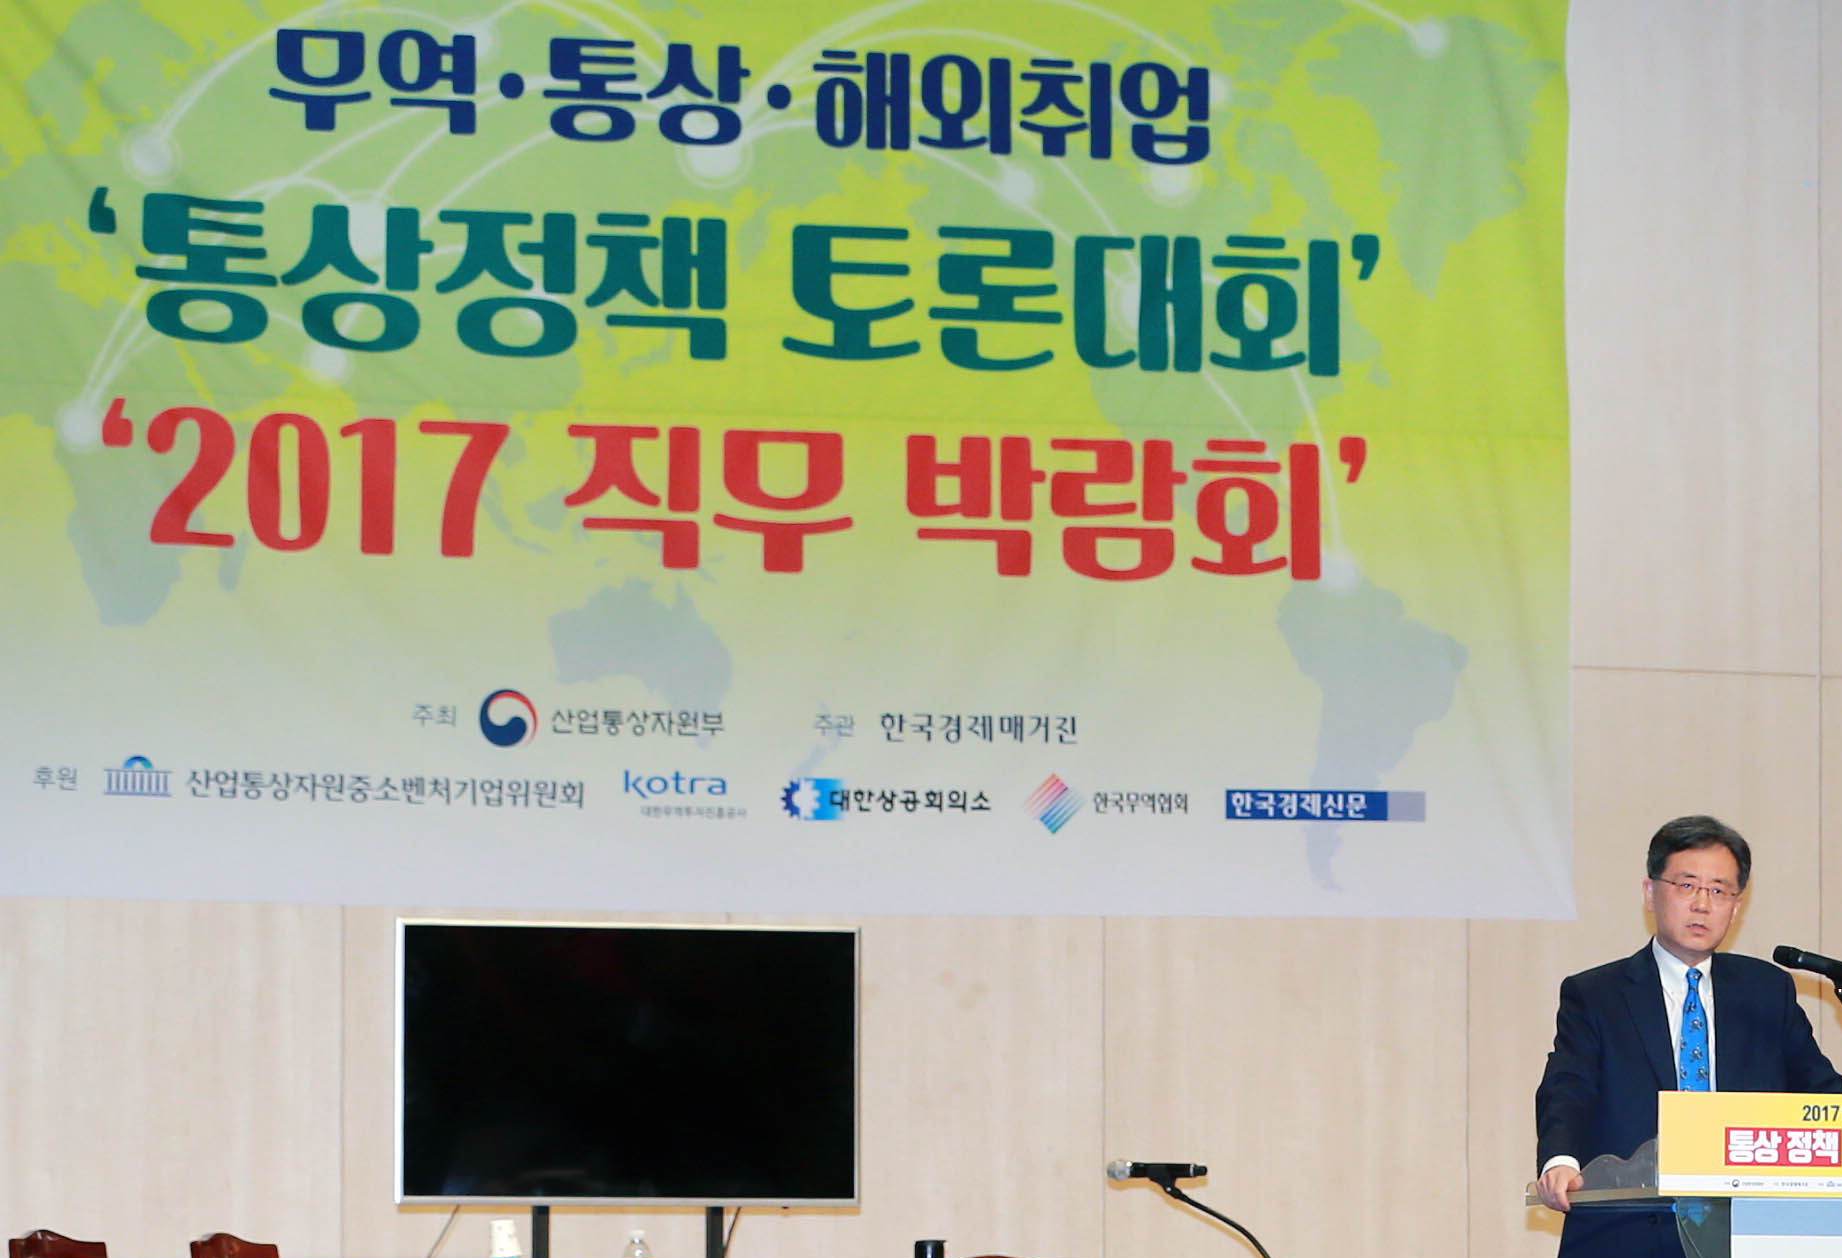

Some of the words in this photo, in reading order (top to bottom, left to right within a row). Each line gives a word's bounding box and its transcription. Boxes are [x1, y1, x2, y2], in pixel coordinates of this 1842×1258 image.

[269, 28, 1211, 166] 무역·통상·해외취업
[564, 422, 854, 574] 직무
[411, 703, 457, 728] 주최
[551, 708, 726, 738] 산업통상자원부
[814, 713, 857, 739] 주관
[879, 711, 1079, 745] 한국경제매거진
[32, 765, 79, 792] 후원
[186, 768, 586, 810] 산업통상자원중소벤처기업위원회
[623, 769, 728, 799] kotra
[829, 788, 992, 814] 대한상공회의소
[1093, 791, 1189, 816] 한국무역협회
[1231, 791, 1367, 818] 한국경제신문
[1802, 1104, 1840, 1122] 2017
[1727, 1129, 1783, 1164] 통상
[1786, 1129, 1840, 1165] 정책
